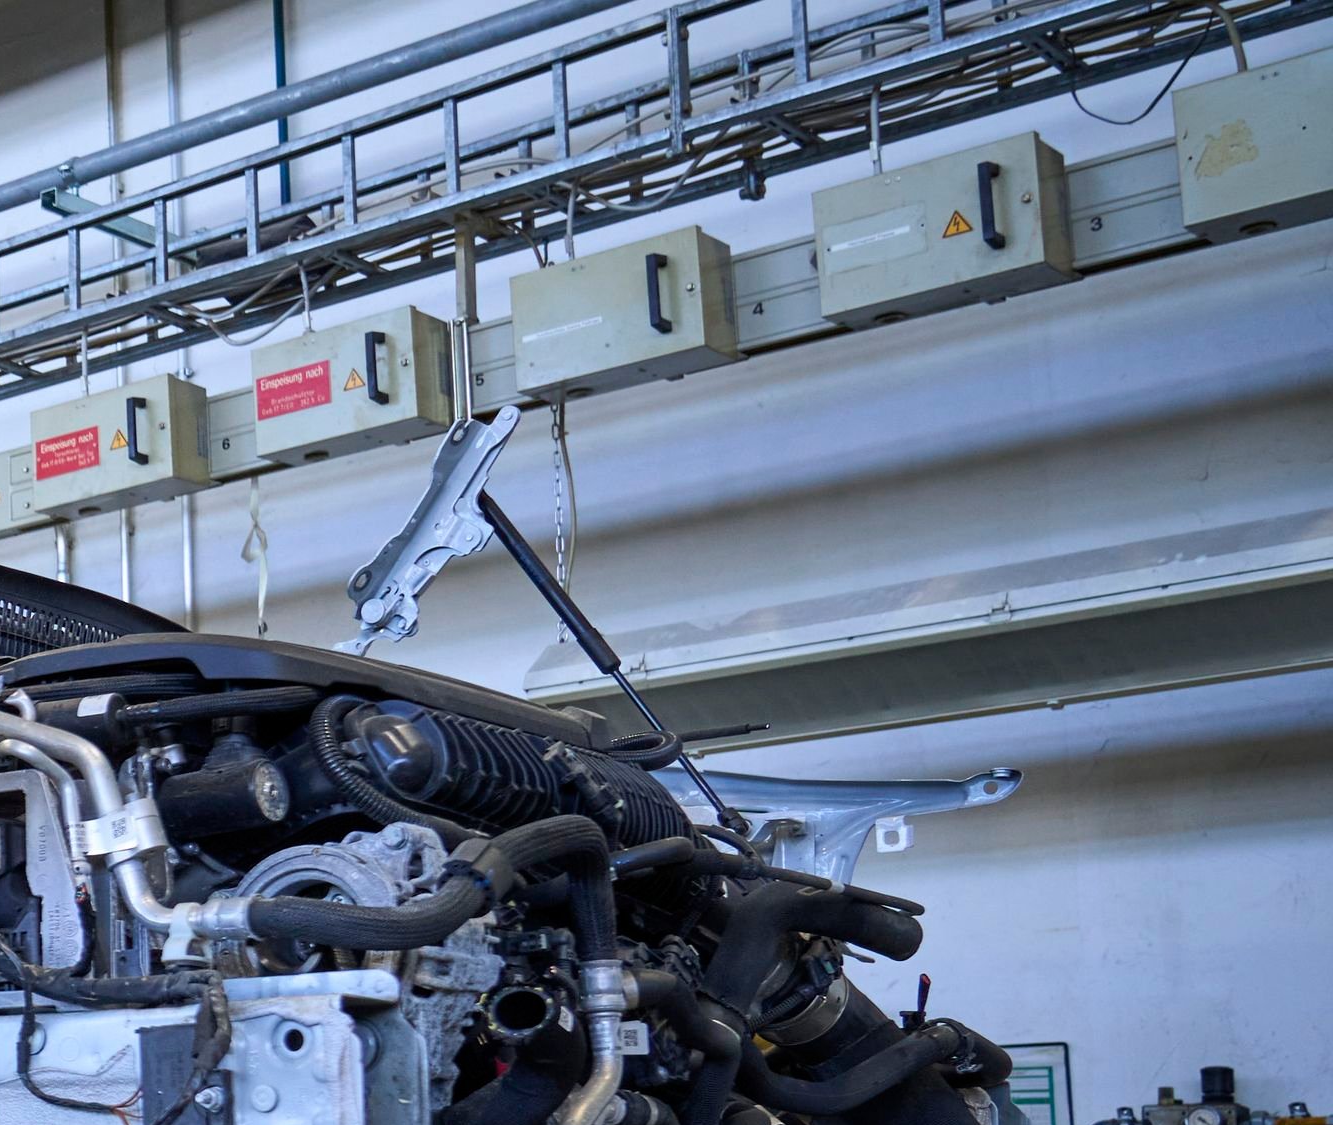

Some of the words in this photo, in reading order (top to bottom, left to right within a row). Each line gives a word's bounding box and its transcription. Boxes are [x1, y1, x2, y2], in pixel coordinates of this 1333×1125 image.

[1090, 217, 1103, 231] 3
[752, 302, 764, 316] 4
[260, 372, 303, 392] Einspeisung
[305, 365, 324, 379] nach
[476, 374, 484, 386] 5
[40, 437, 76, 454] Einspeisung
[78, 431, 94, 444] nach
[222, 438, 230, 450] 6
